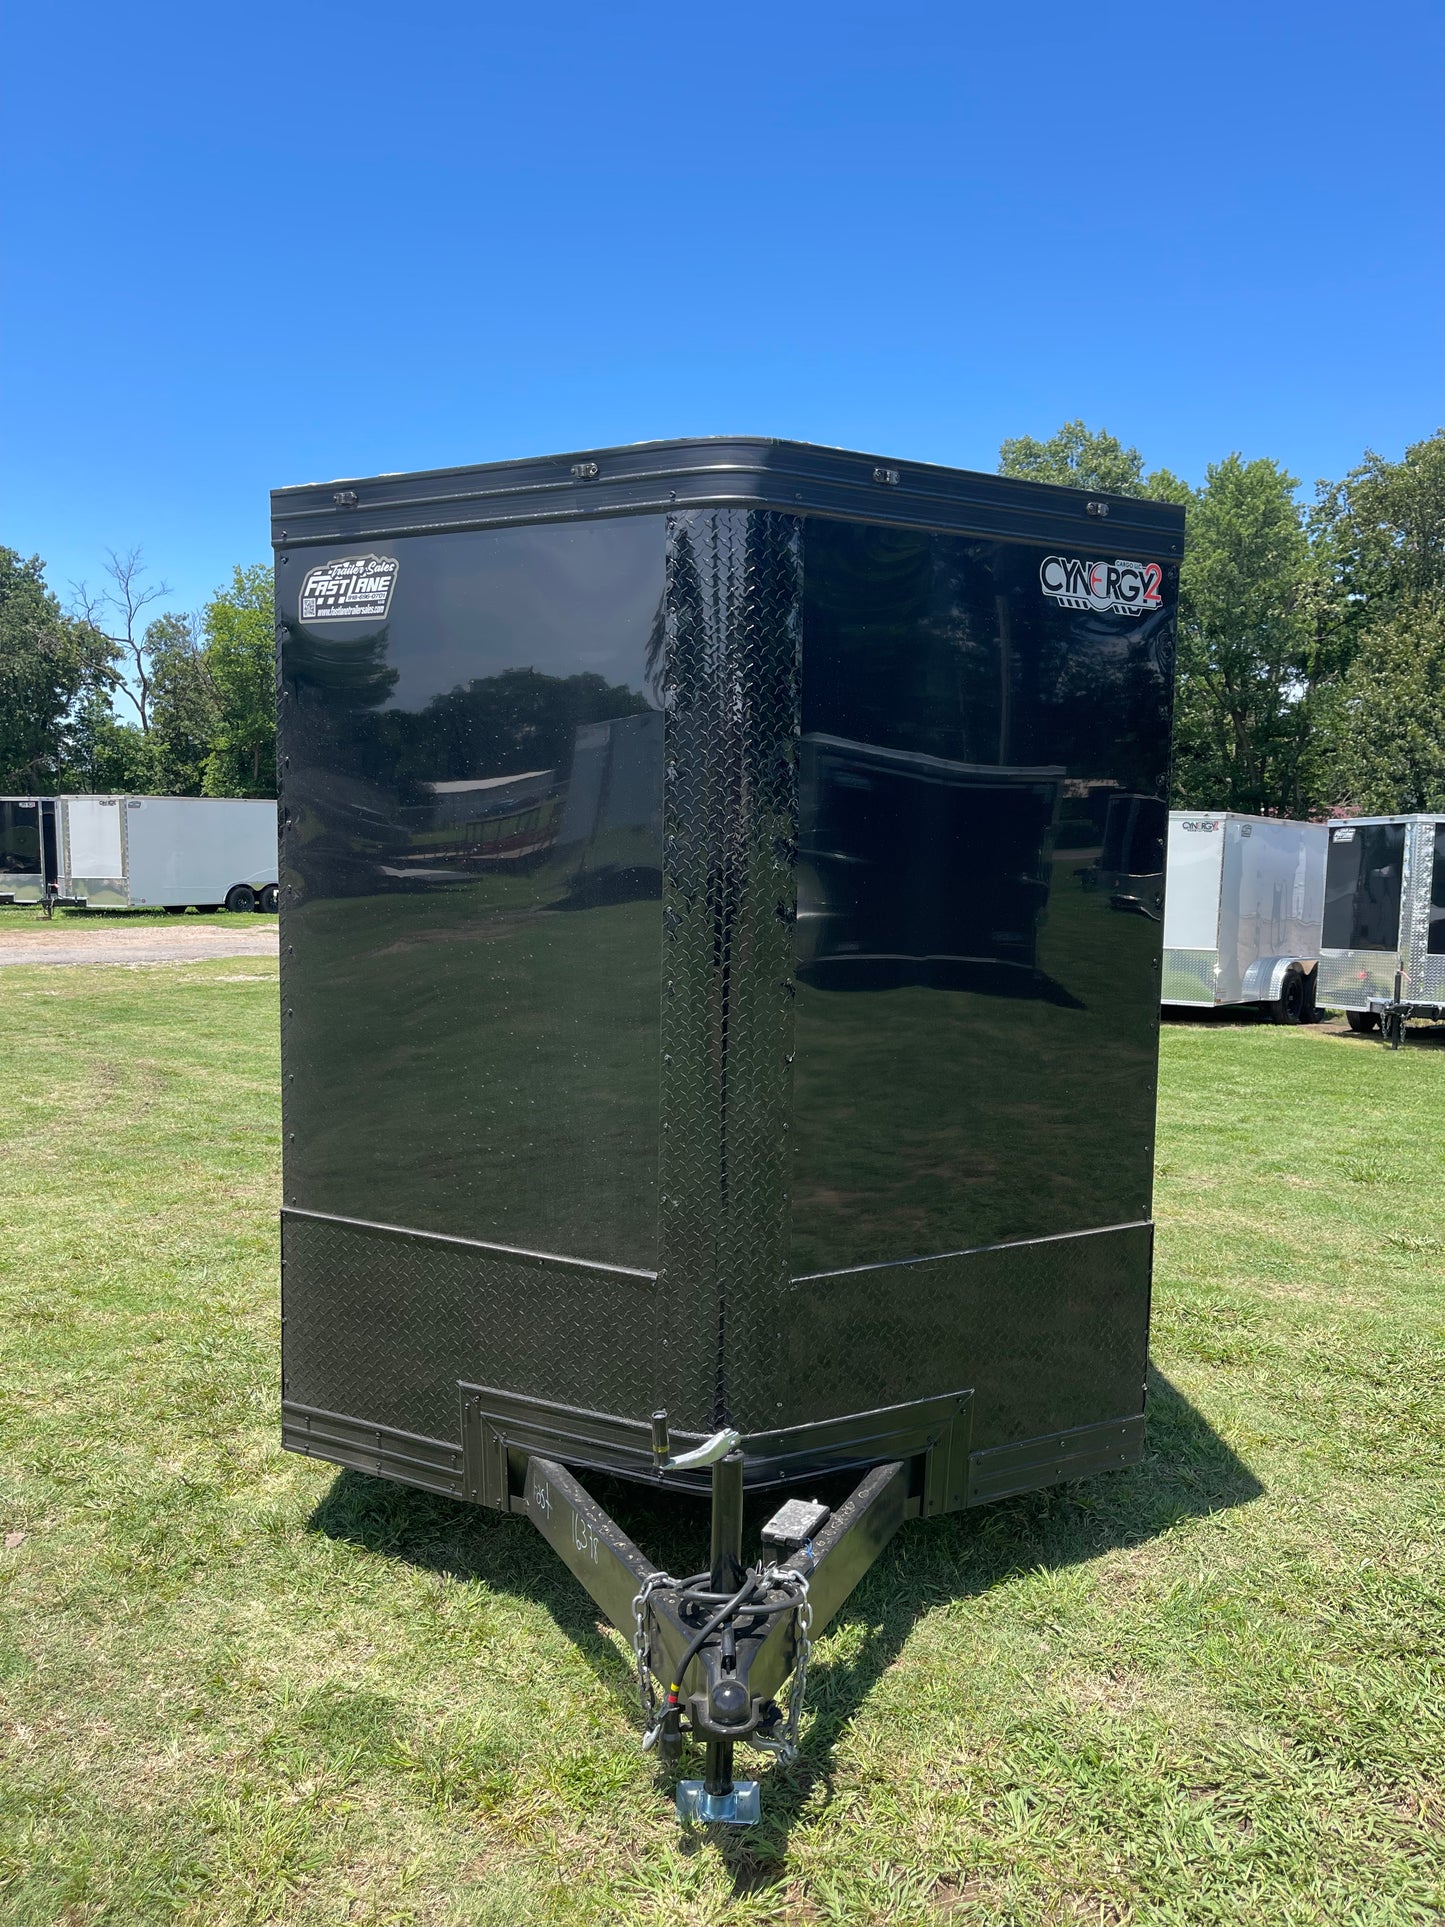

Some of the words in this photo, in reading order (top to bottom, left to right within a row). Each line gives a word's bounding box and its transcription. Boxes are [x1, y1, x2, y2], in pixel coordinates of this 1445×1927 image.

[331, 564, 364, 577] Trailer
[367, 561, 395, 575] Sales
[1116, 560, 1134, 569] CARGO
[571, 1510, 599, 1565] 16378
